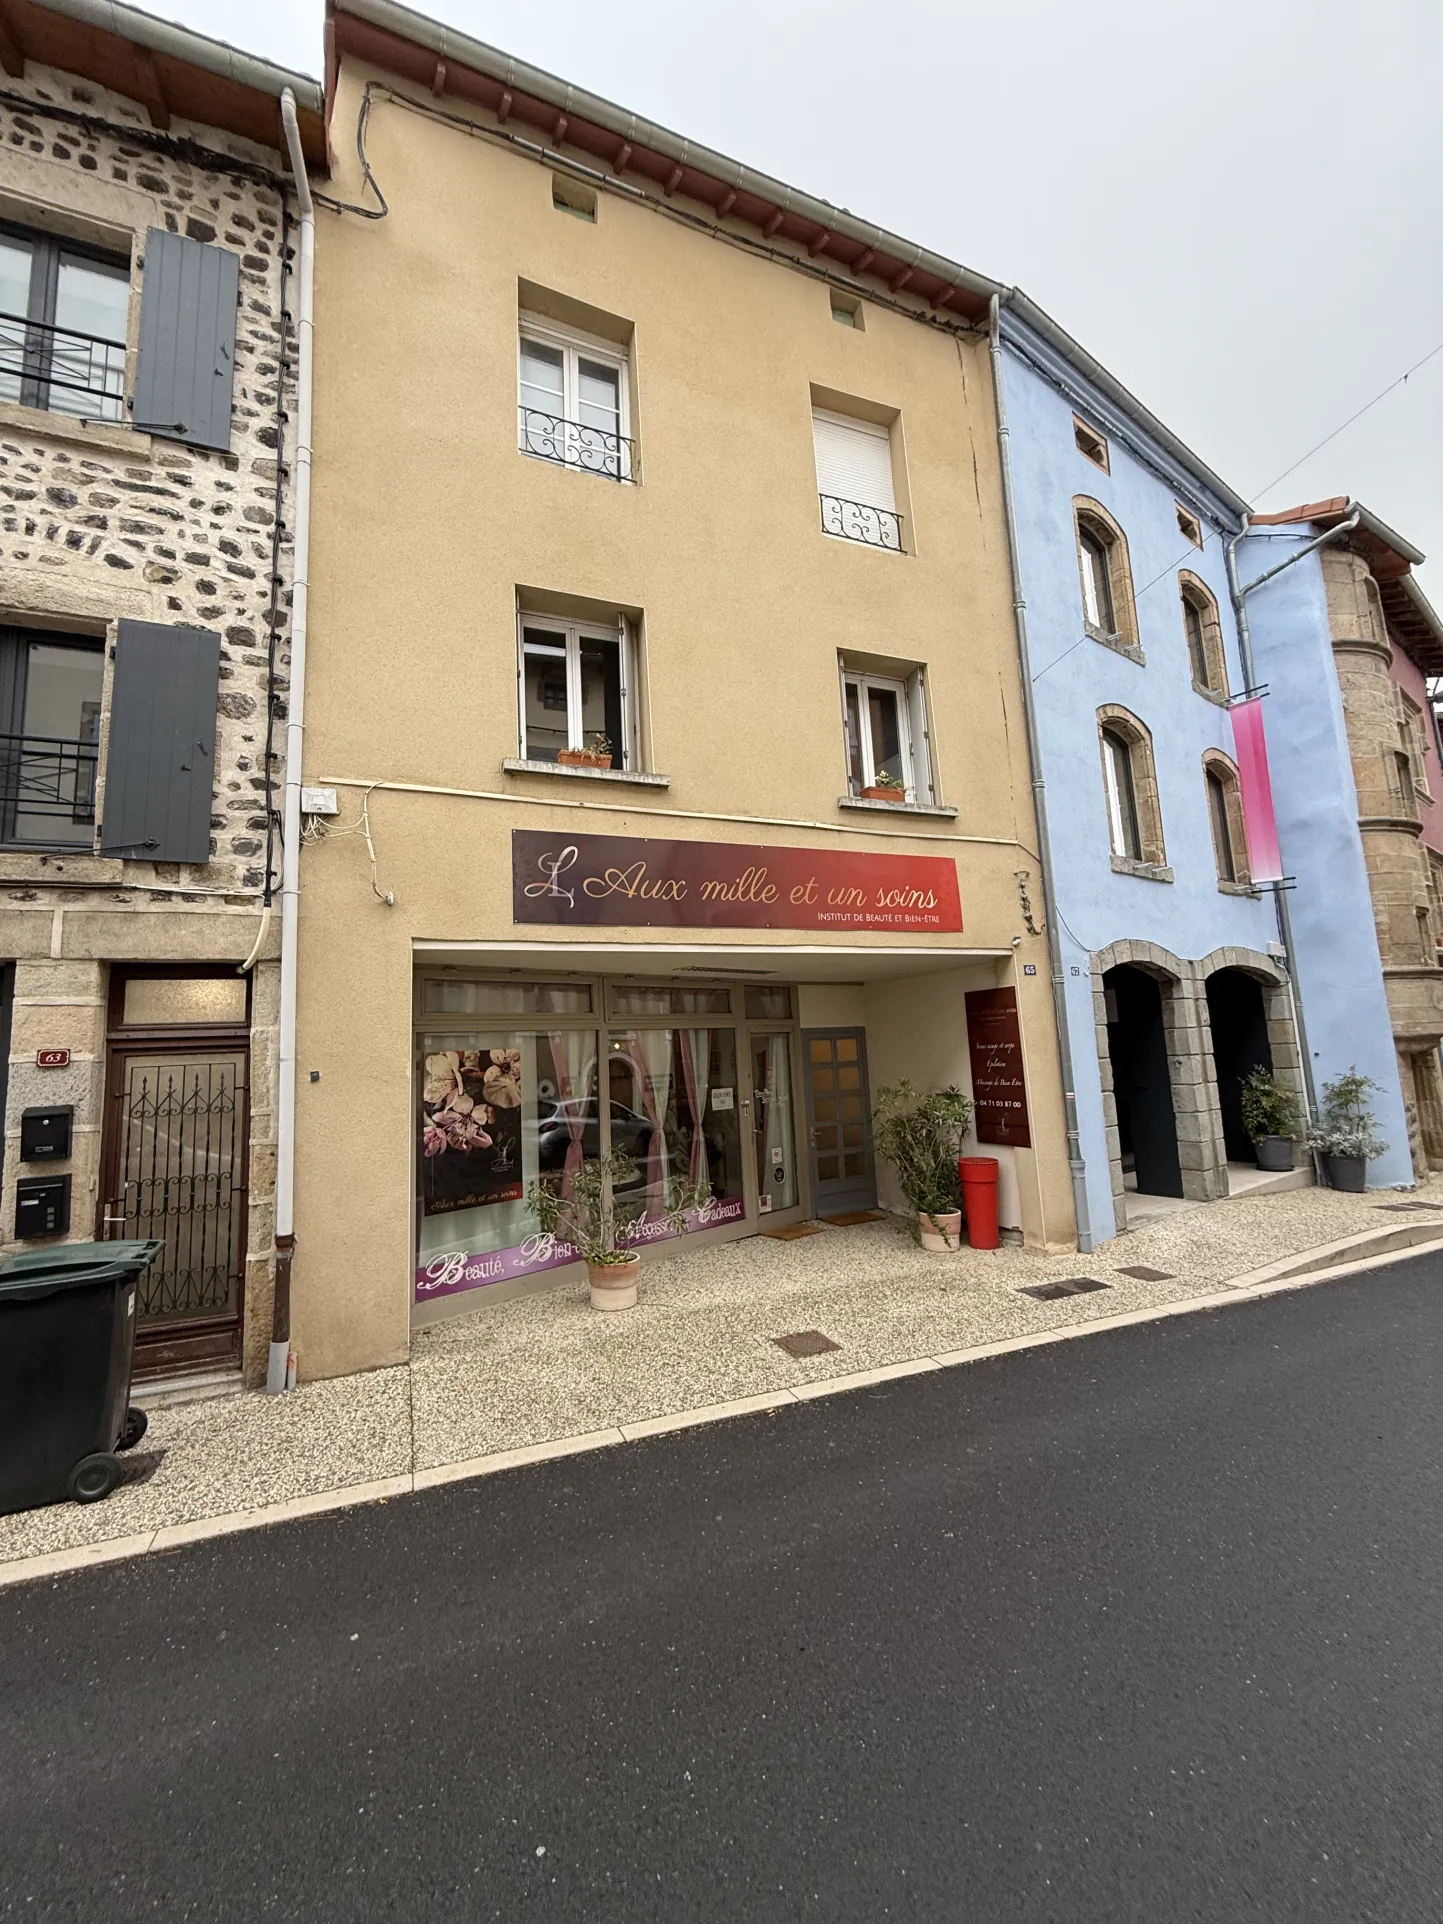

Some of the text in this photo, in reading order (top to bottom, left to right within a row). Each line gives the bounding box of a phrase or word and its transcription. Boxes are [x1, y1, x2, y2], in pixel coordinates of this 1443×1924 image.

[582, 861, 938, 909] Aux mille et un soins
[817, 912, 851, 922] INSTITUT
[853, 913, 864, 922] DE
[865, 912, 893, 923] BEAUTÉ
[894, 913, 902, 923] ET
[1025, 966, 1035, 975] 65
[45, 1053, 61, 1063] 63
[713, 1091, 731, 1099] OUVERT
[417, 1250, 505, 1290] Beauté,
